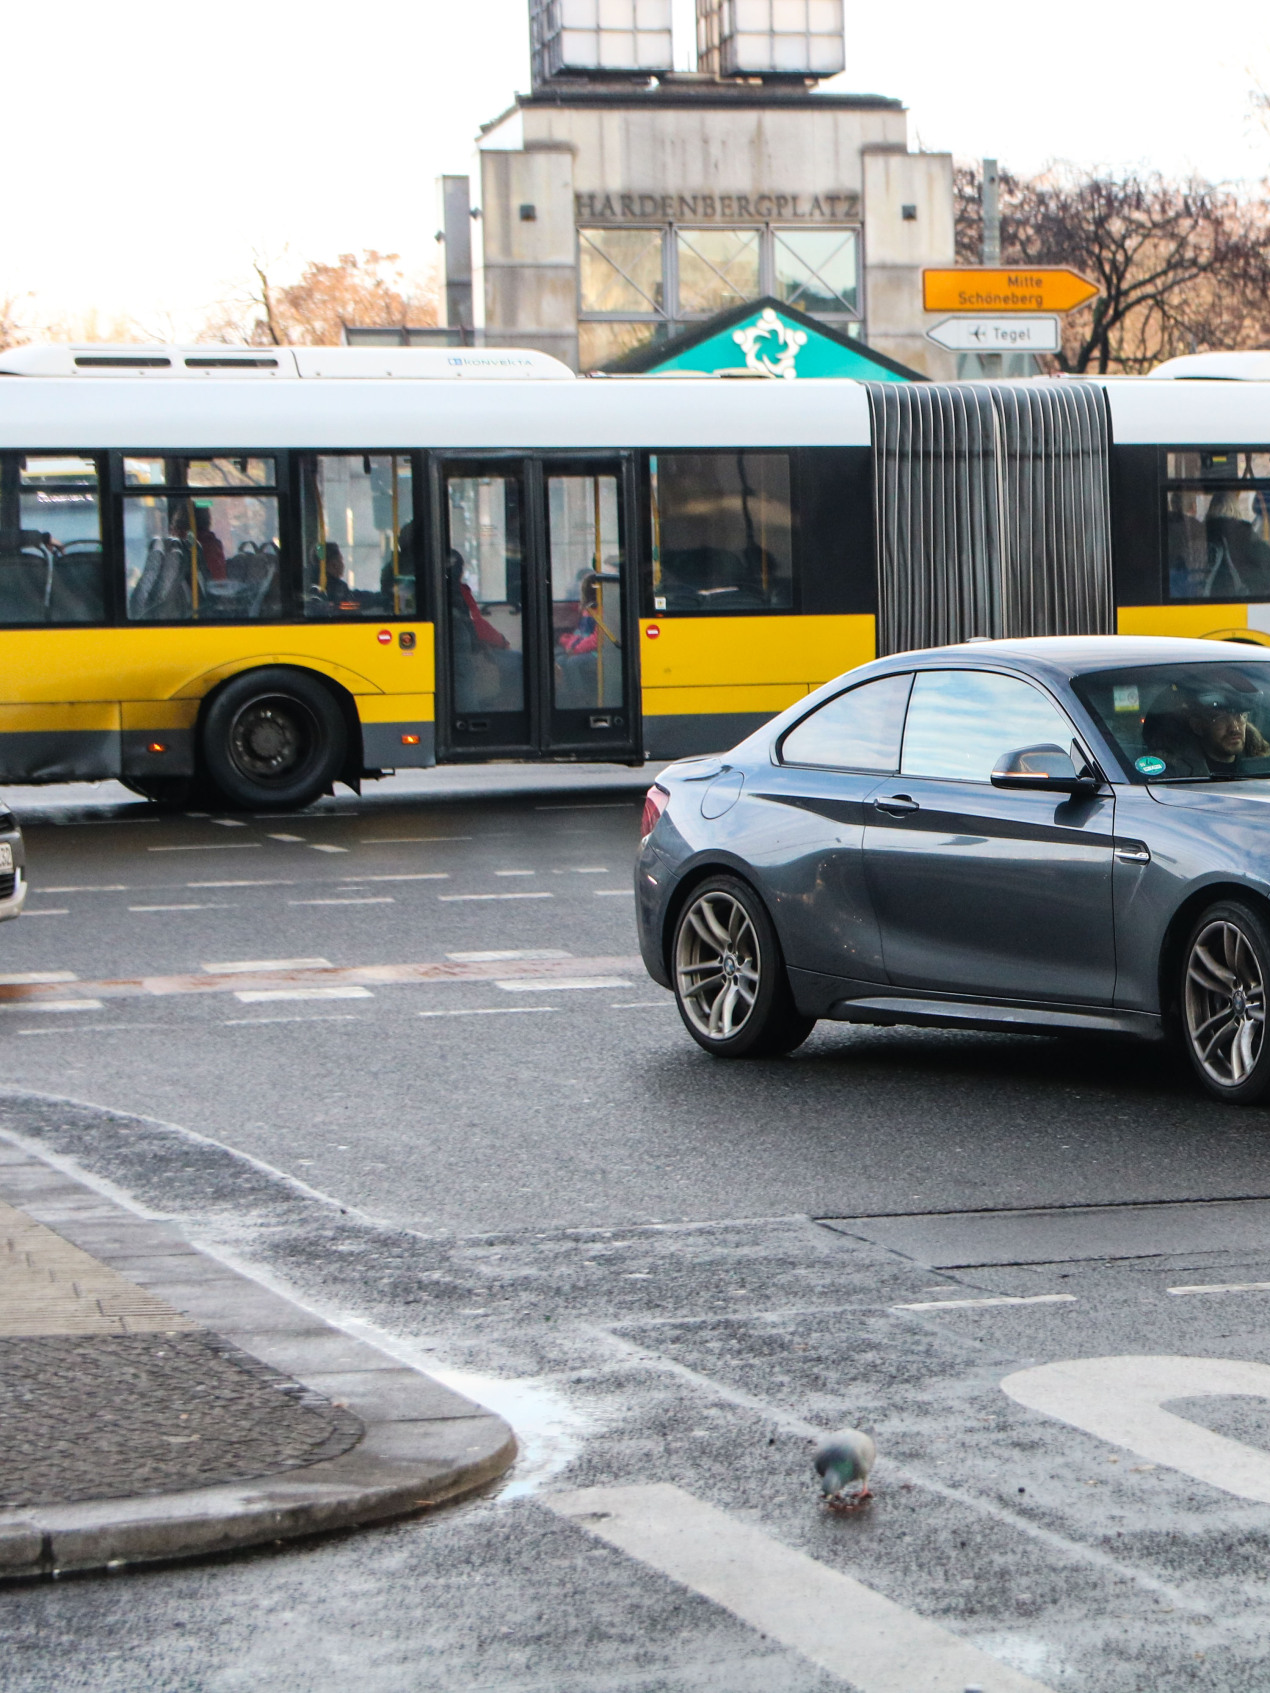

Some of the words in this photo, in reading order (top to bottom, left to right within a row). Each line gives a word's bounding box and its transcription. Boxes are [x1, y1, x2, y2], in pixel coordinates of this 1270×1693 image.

[575, 194, 861, 218] HARDENBERGPLATZ
[1007, 275, 1043, 288] Mitte
[958, 291, 1044, 307] Schöneberg
[993, 327, 1031, 344] Tegel
